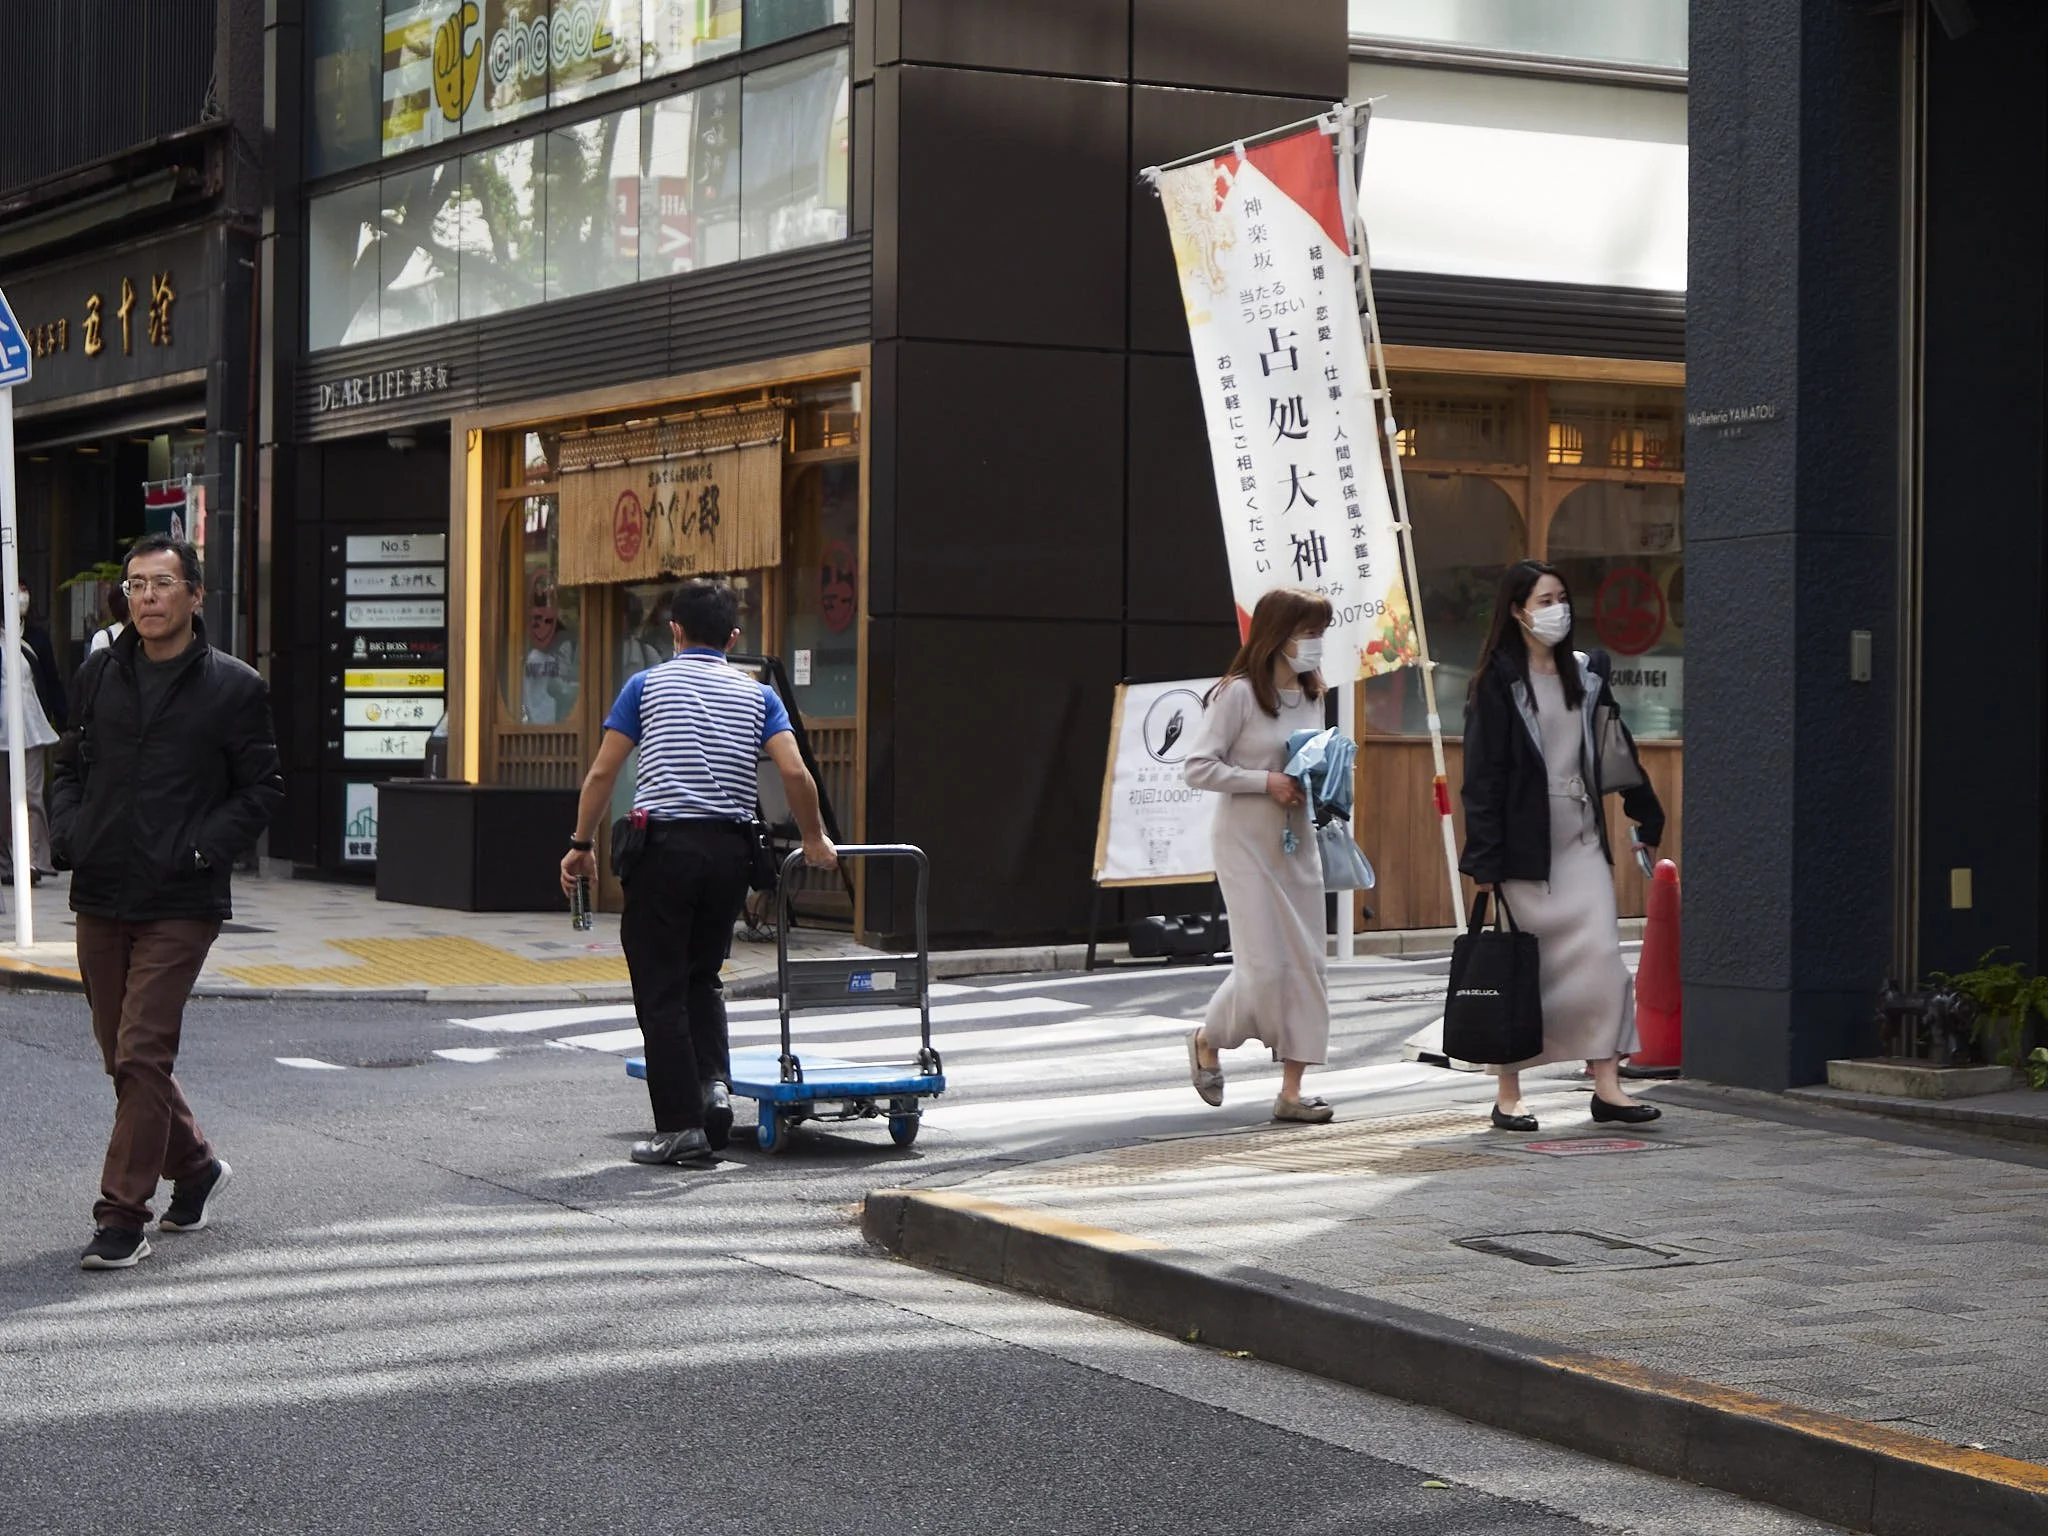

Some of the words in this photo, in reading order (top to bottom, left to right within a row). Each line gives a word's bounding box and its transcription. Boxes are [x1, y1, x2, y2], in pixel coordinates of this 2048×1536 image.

[1243, 197, 1273, 270] 神楽坂
[1239, 281, 1287, 305] 当たる
[1242, 297, 1307, 325] うらない
[319, 378, 363, 411] DEAR
[368, 370, 405, 402] LIFE
[1217, 354, 1272, 574] お気軽にご相談ください
[1259, 327, 1329, 582] 占処大神
[1610, 670, 1667, 687] GURATEI
[349, 841, 377, 855] 管理
